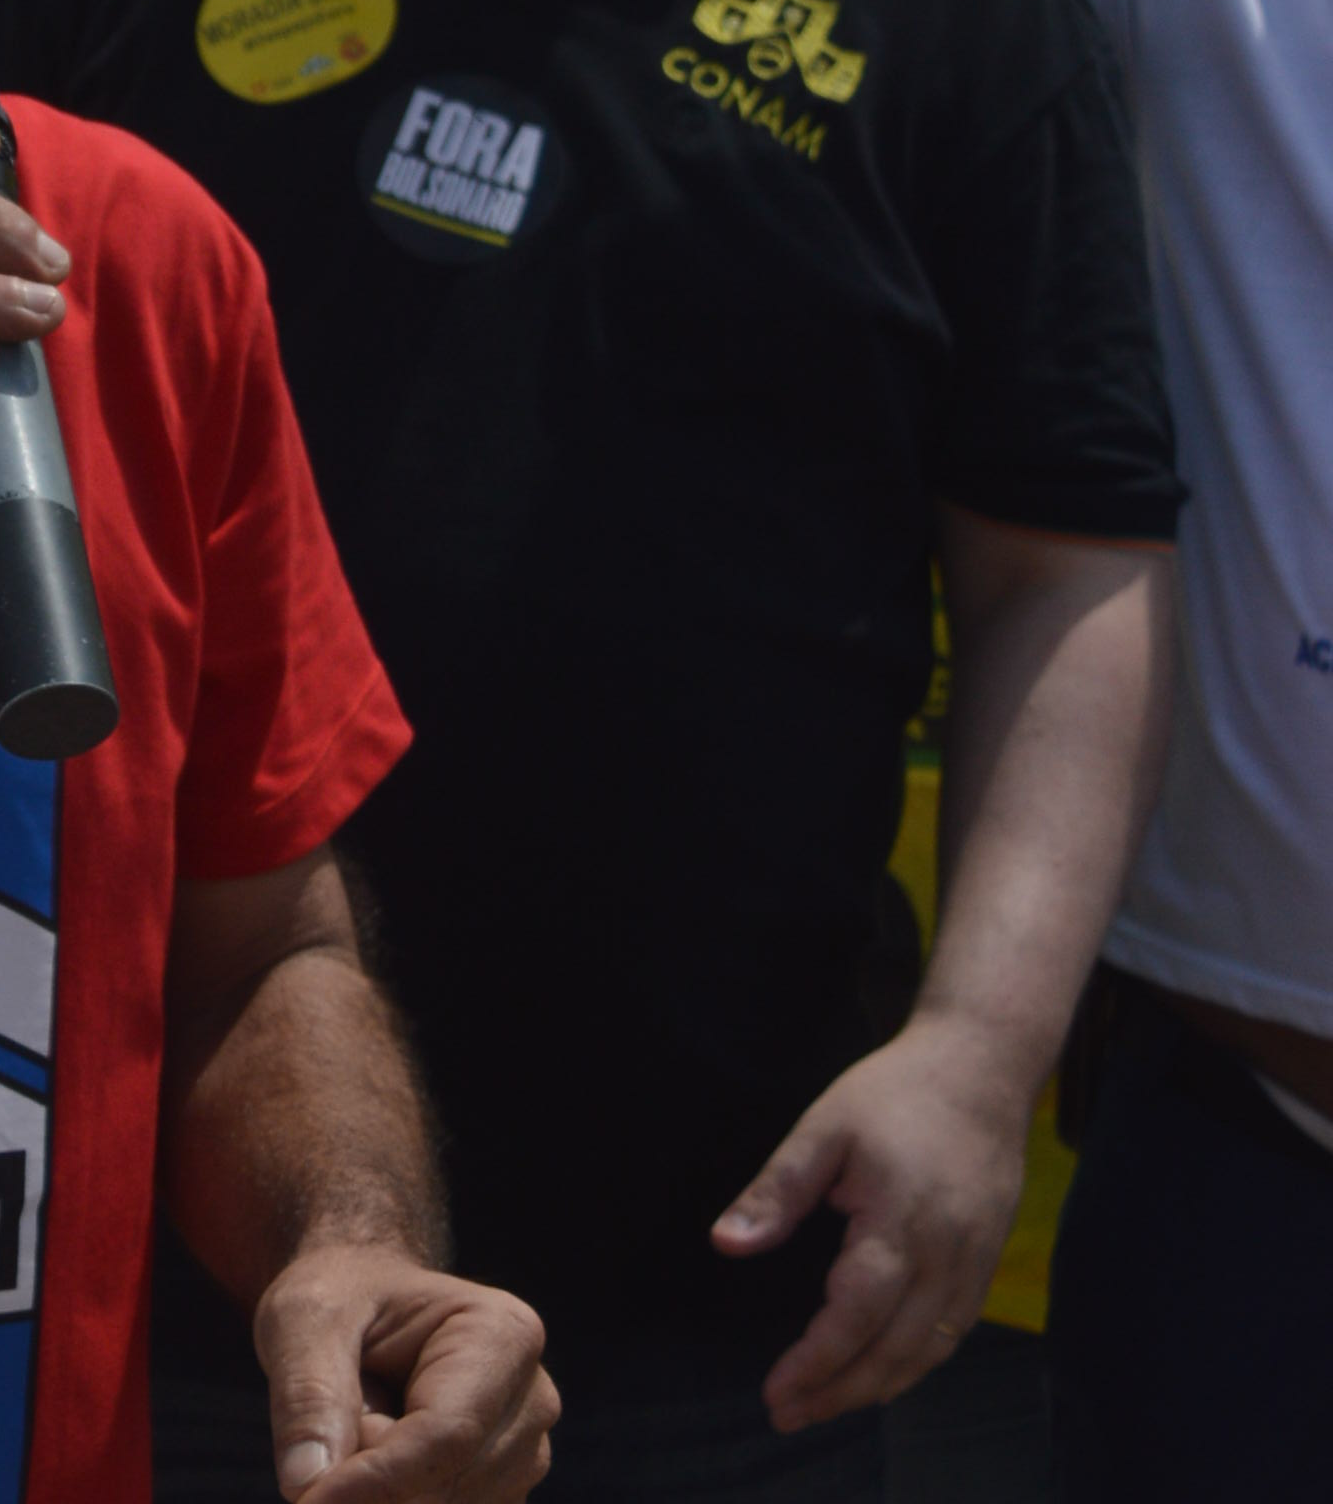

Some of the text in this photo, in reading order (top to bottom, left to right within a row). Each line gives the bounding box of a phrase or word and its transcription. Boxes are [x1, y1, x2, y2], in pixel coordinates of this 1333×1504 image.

[393, 86, 544, 191] FORA
[661, 46, 829, 162] CONAM
[375, 150, 530, 237] BOLSONARO
